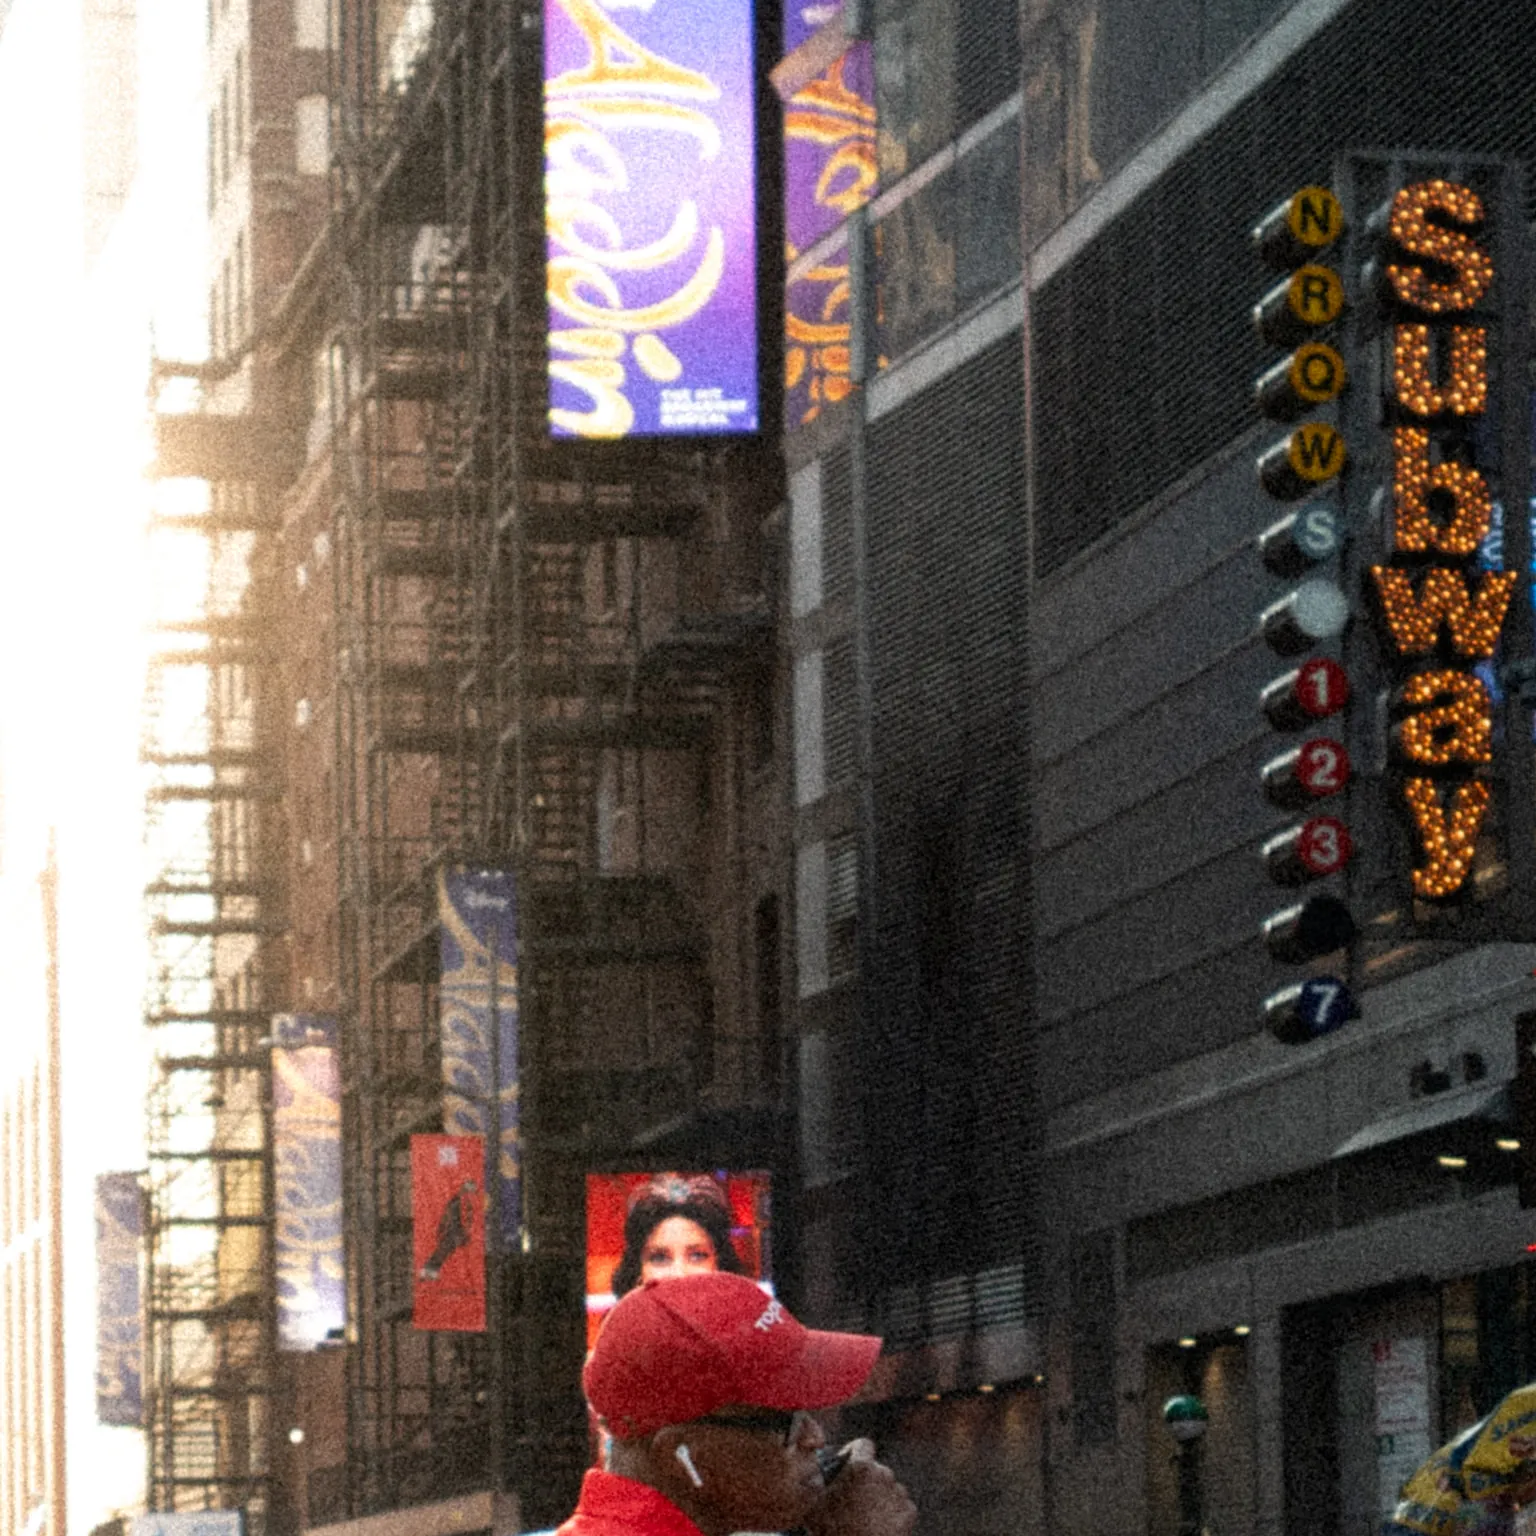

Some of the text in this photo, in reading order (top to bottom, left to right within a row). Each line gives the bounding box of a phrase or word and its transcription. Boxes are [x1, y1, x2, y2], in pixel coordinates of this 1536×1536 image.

[545, 0, 722, 439] Aladdin
[1300, 198, 1331, 235] N
[1301, 273, 1331, 310] R
[1302, 356, 1335, 393] Q
[1300, 433, 1337, 469] W
[1304, 510, 1336, 550] S
[1372, 178, 1518, 897] Subway
[1309, 668, 1330, 707] 1
[1310, 746, 1338, 788] 2
[1310, 825, 1340, 868] 3
[1311, 983, 1339, 1024] 7
